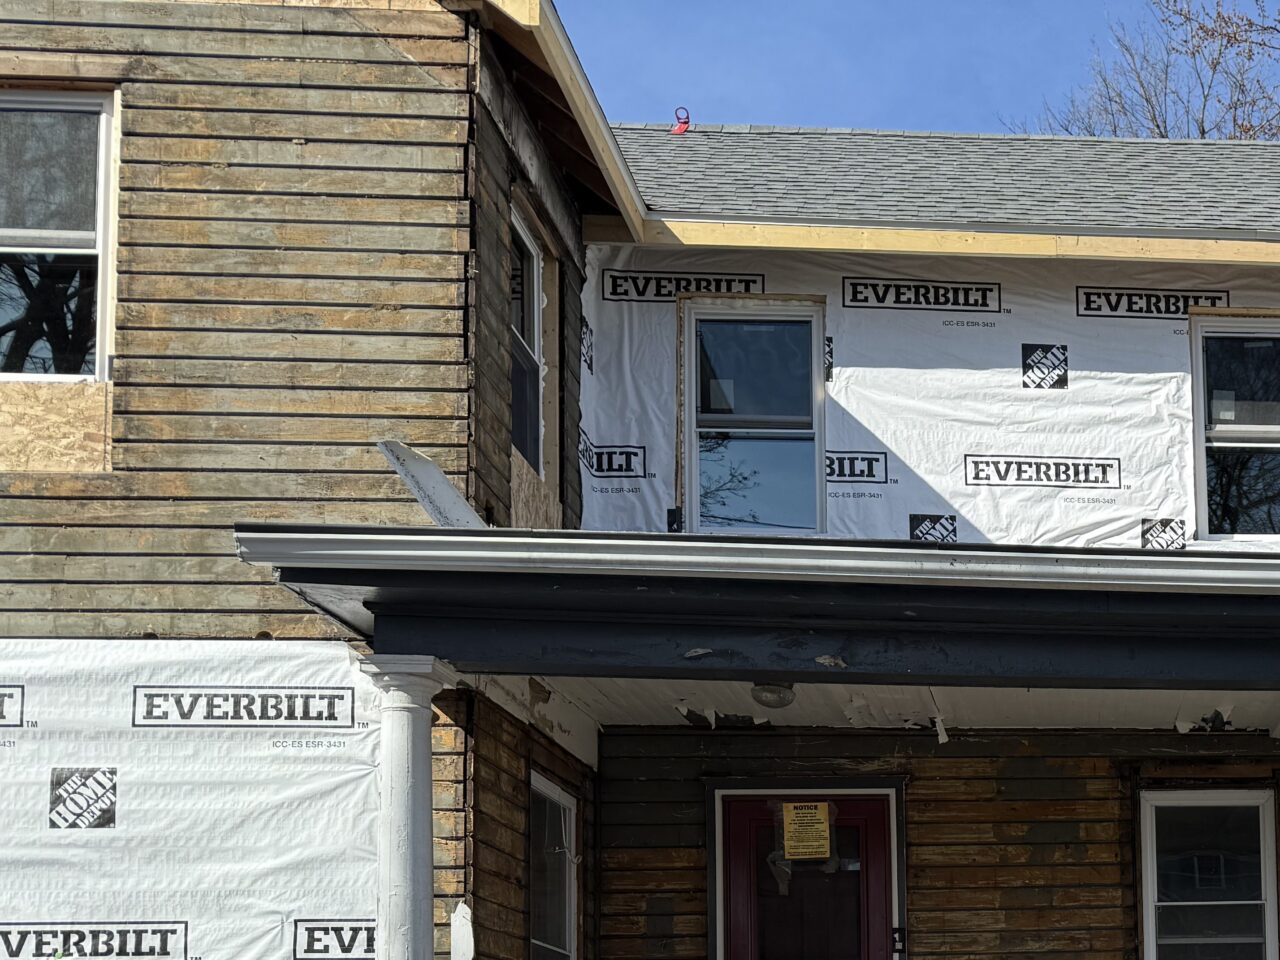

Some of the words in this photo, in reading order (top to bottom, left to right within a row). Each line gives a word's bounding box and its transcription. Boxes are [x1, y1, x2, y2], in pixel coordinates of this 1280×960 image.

[849, 282, 993, 307] EVERBILT
[1022, 344, 1068, 388] HOME
[1026, 348, 1045, 366] THE
[1040, 361, 1068, 389] DEPOT
[971, 460, 1113, 484] EVERBILT
[914, 518, 934, 537] THE
[1145, 521, 1164, 541] THE
[1146, 518, 1185, 549] OME
[142, 693, 345, 721] EVERBILT
[25, 720, 38, 728] TM
[272, 740, 303, 748] ICC-ES
[305, 740, 346, 748] ESR-3431
[49, 767, 117, 828] HOME
[56, 773, 85, 798] THE
[75, 789, 116, 828] DEPOT
